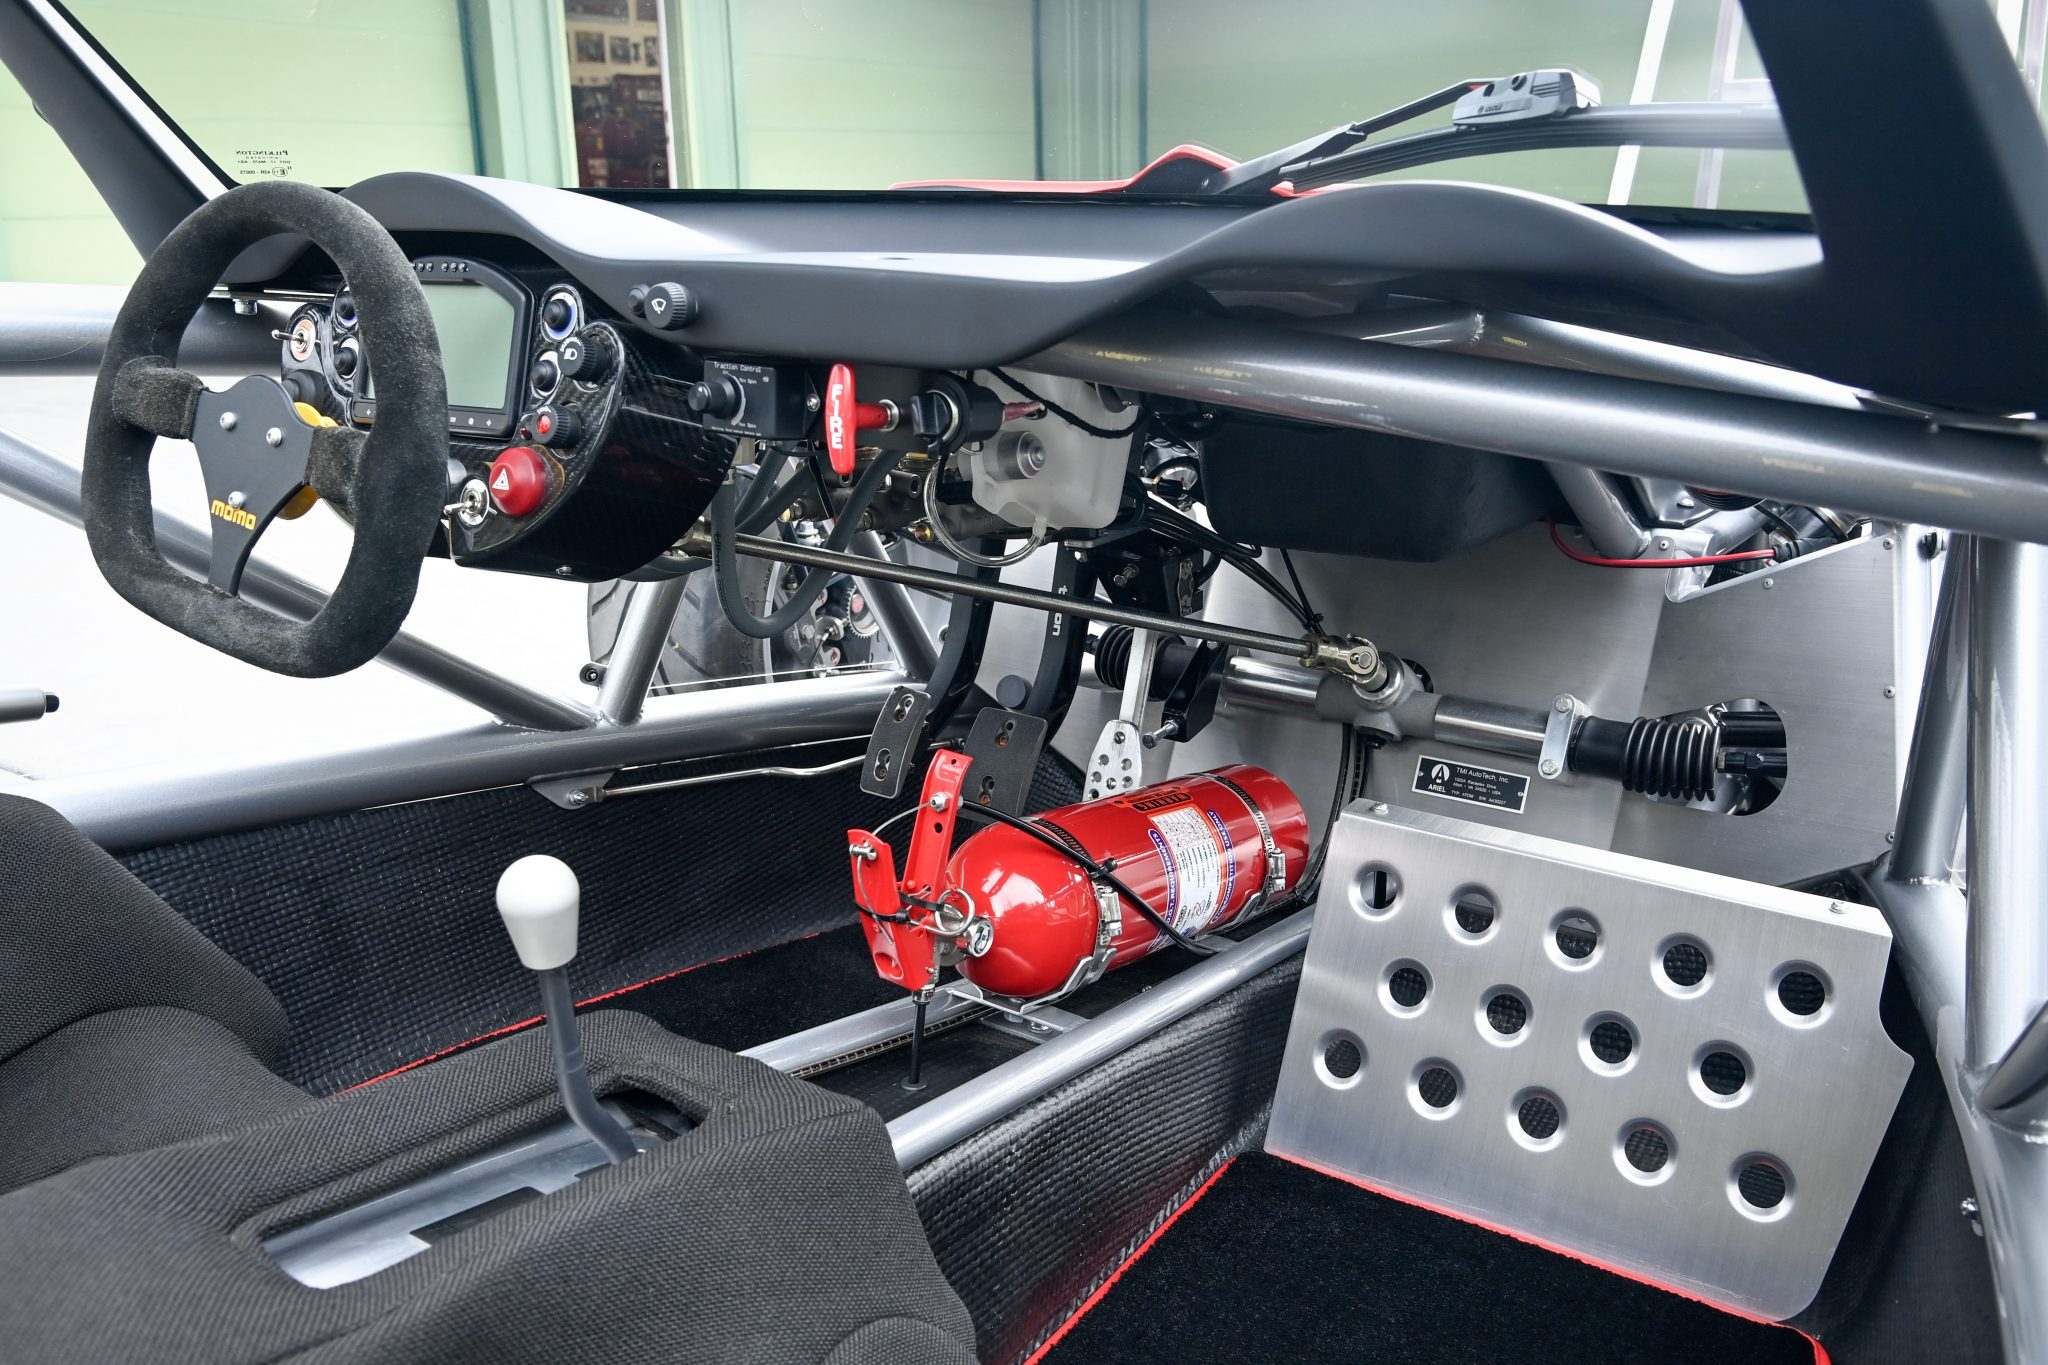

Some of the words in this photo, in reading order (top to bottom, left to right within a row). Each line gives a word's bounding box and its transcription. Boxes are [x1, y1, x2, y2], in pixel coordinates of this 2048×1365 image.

[714, 361, 739, 371] Traction
[740, 364, 762, 373] Control
[830, 383, 844, 450] FIRE
[1456, 767, 1468, 775] TMI
[1428, 783, 1447, 793] ARIEL
[1208, 810, 1224, 830] ONLY
[1220, 829, 1230, 848] USE
